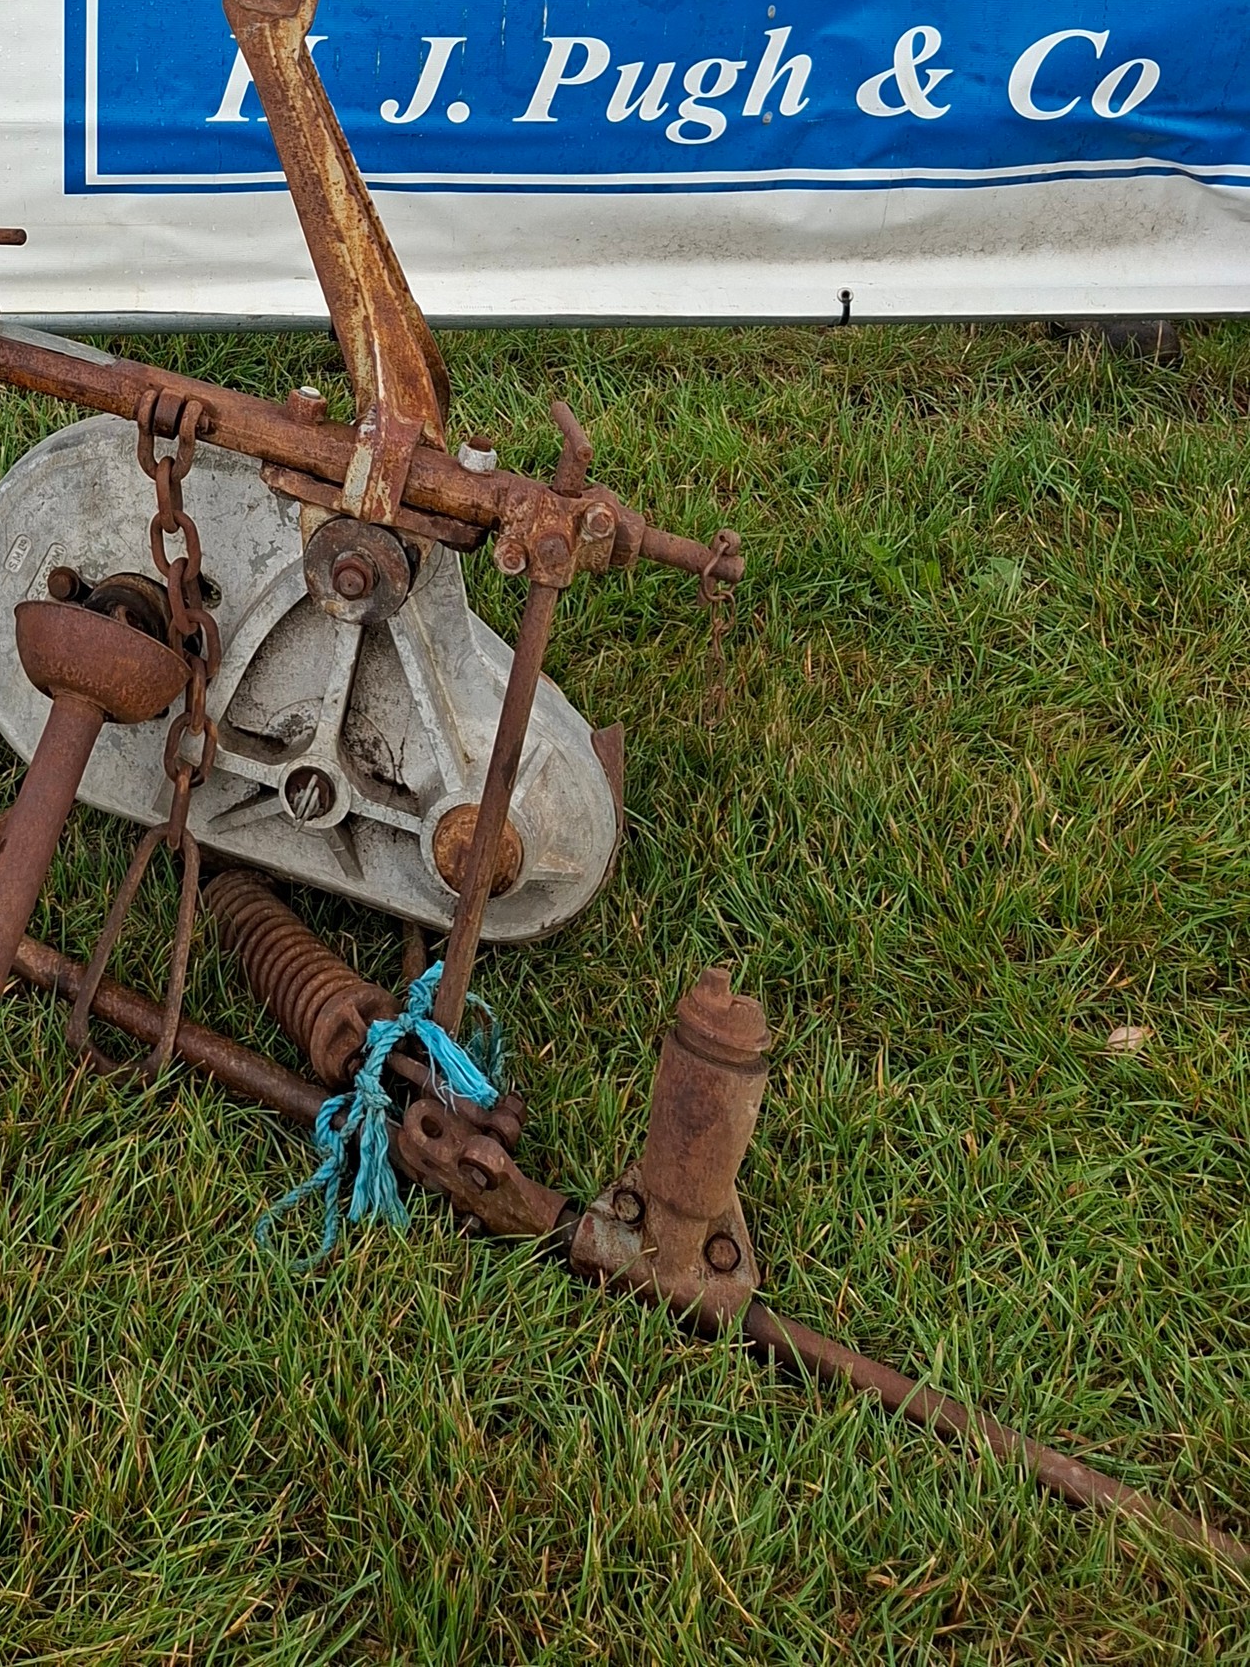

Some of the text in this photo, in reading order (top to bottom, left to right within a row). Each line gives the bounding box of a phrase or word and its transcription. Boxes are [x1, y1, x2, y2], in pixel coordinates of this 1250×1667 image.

[380, 37, 470, 124] J.
[513, 26, 812, 145] Pugh
[855, 25, 953, 120] &
[1008, 29, 1161, 121] Co
